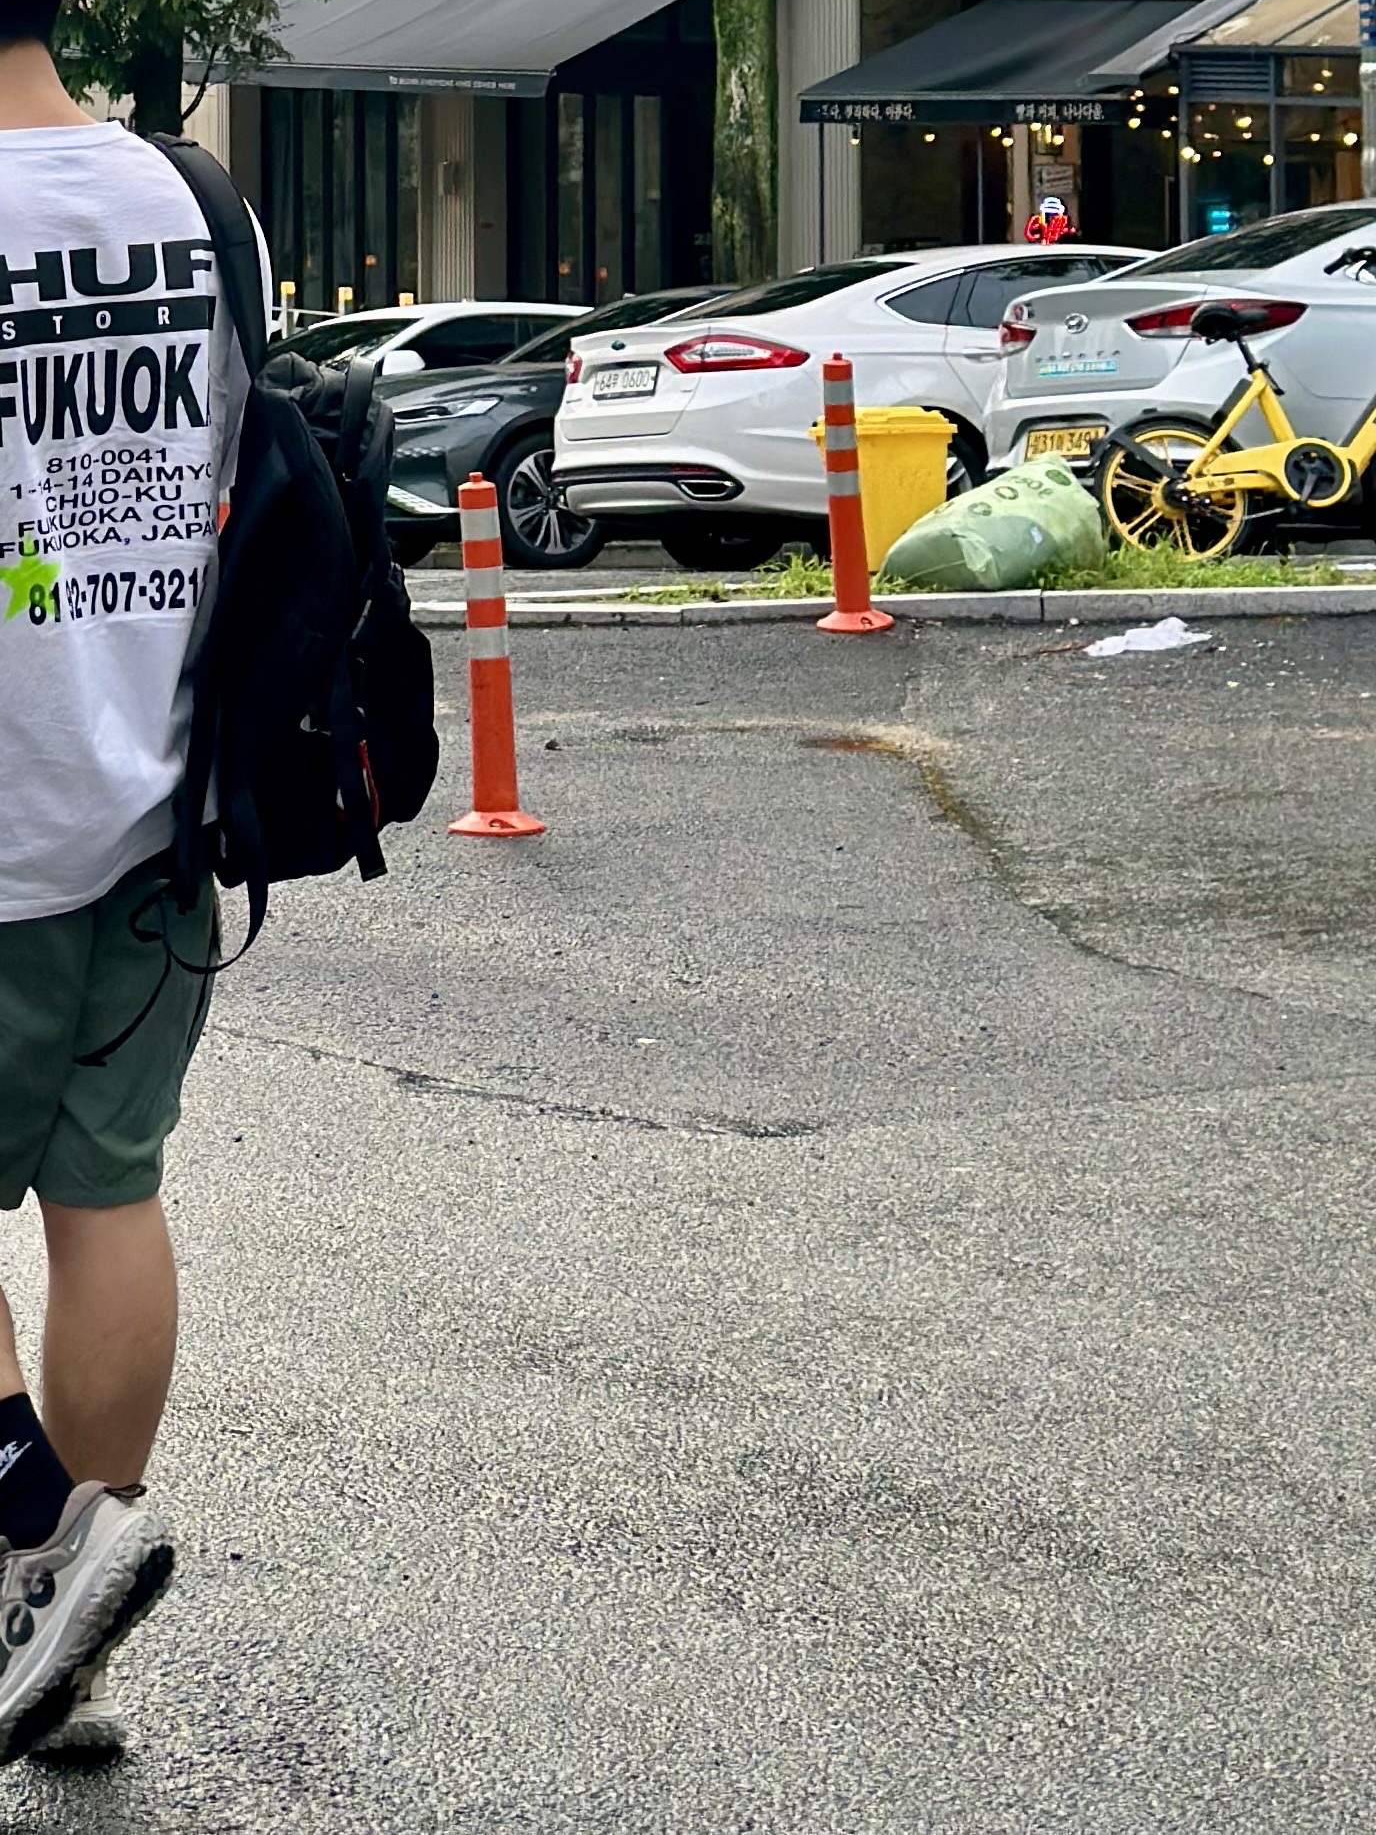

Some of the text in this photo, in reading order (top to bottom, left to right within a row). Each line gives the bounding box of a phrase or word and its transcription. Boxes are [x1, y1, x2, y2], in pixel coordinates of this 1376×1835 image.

[622, 368, 650, 389] 0600
[46, 447, 168, 474] 810-0041
[46, 485, 182, 513] CHUO-KU
[18, 500, 213, 537] FUKUOKA CITY
[142, 519, 218, 542] JAPA
